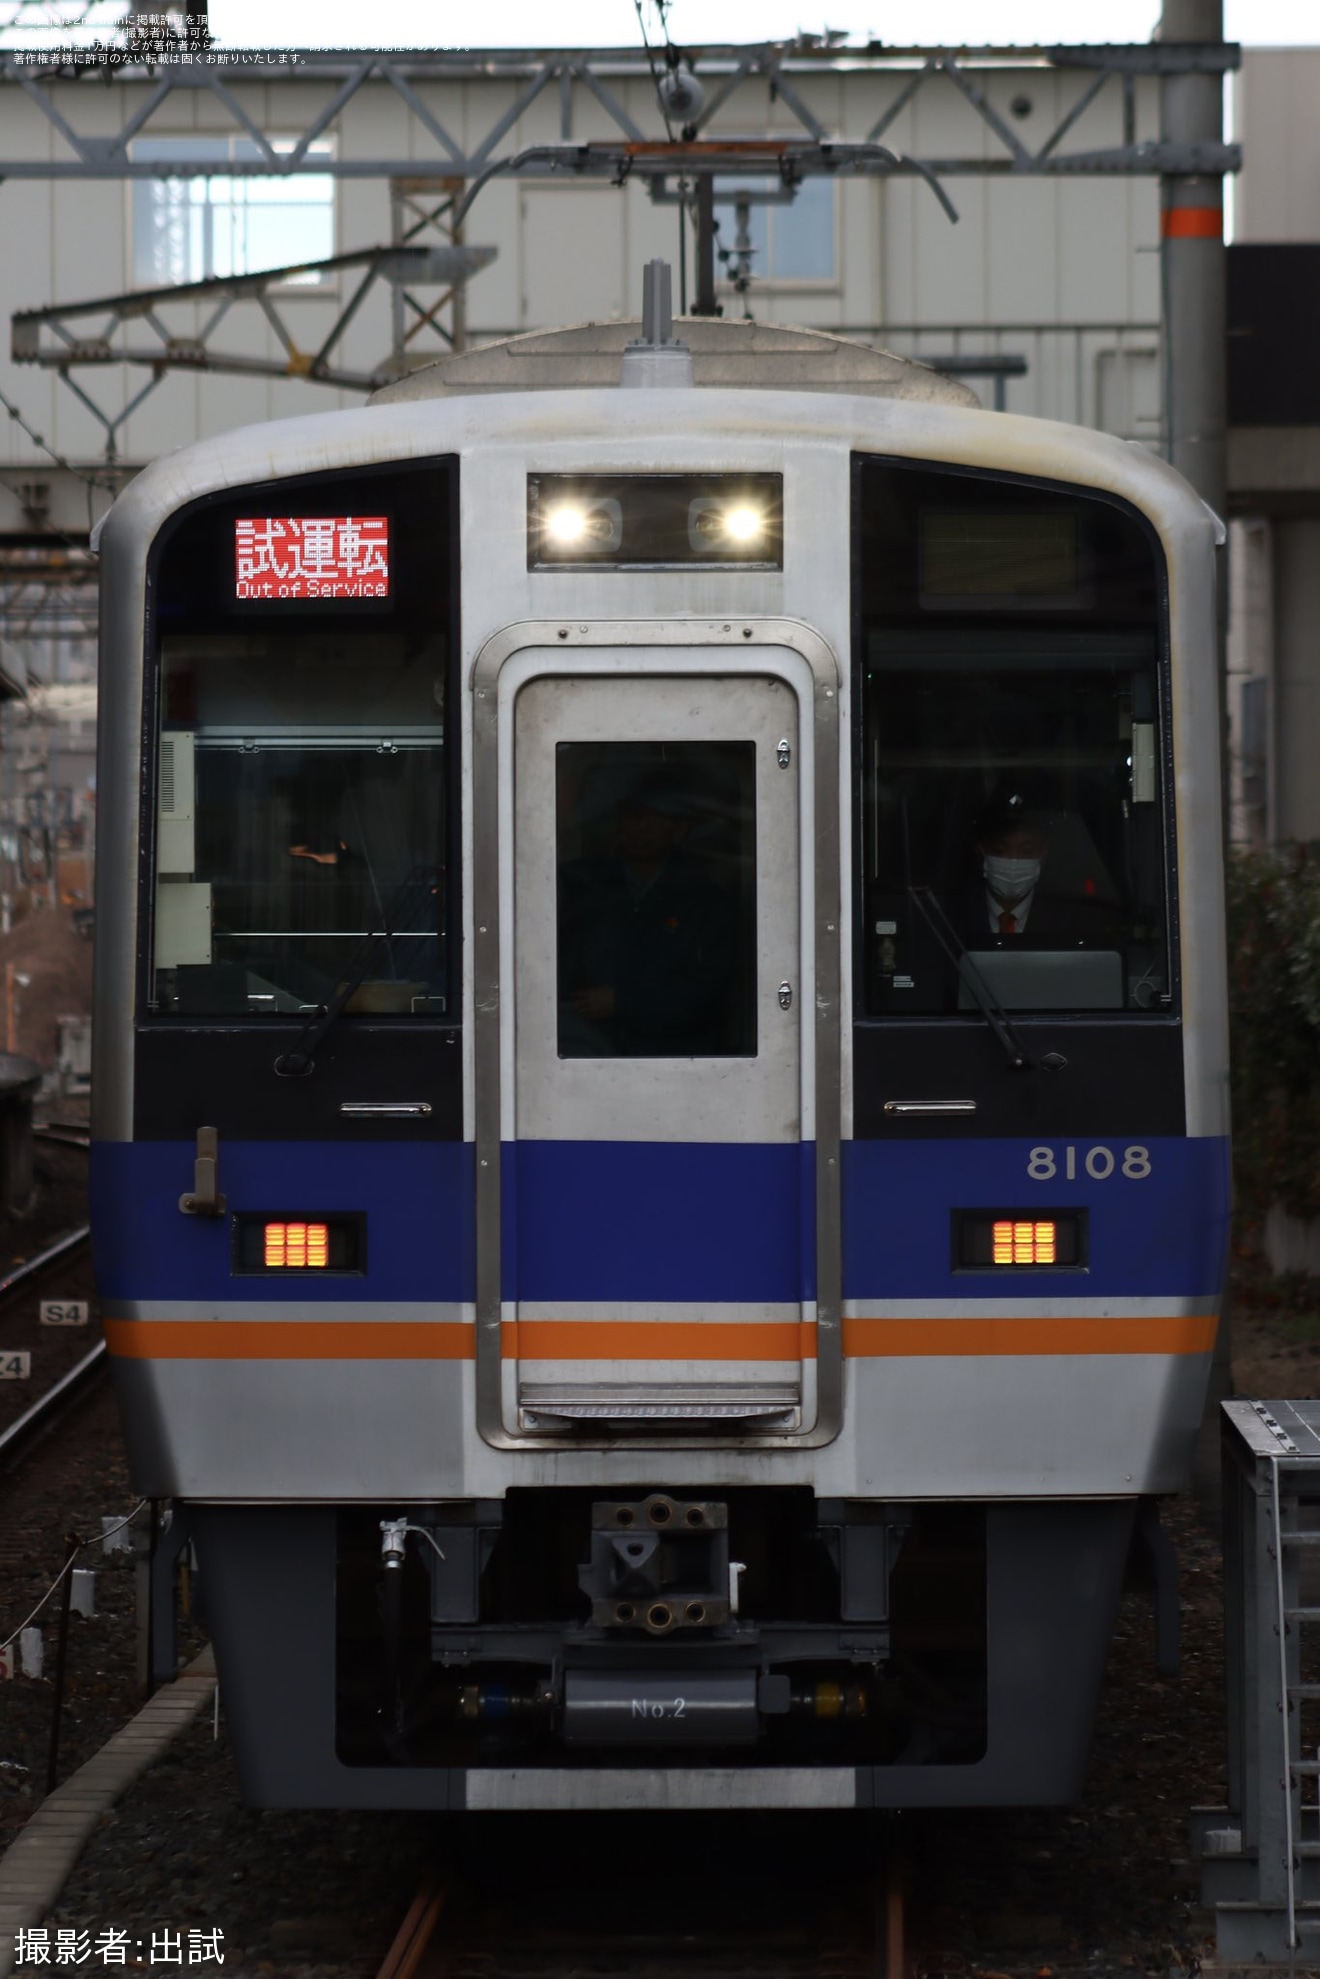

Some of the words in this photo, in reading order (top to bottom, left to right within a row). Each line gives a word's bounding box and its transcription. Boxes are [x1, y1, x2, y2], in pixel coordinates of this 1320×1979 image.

[236, 517, 388, 578] 試運転
[236, 580, 273, 599] Out
[278, 581, 301, 599] of
[306, 578, 386, 598] Service
[1027, 1146, 1152, 1180] 8108
[46, 1305, 82, 1323] S4
[631, 1697, 686, 1719] No.2
